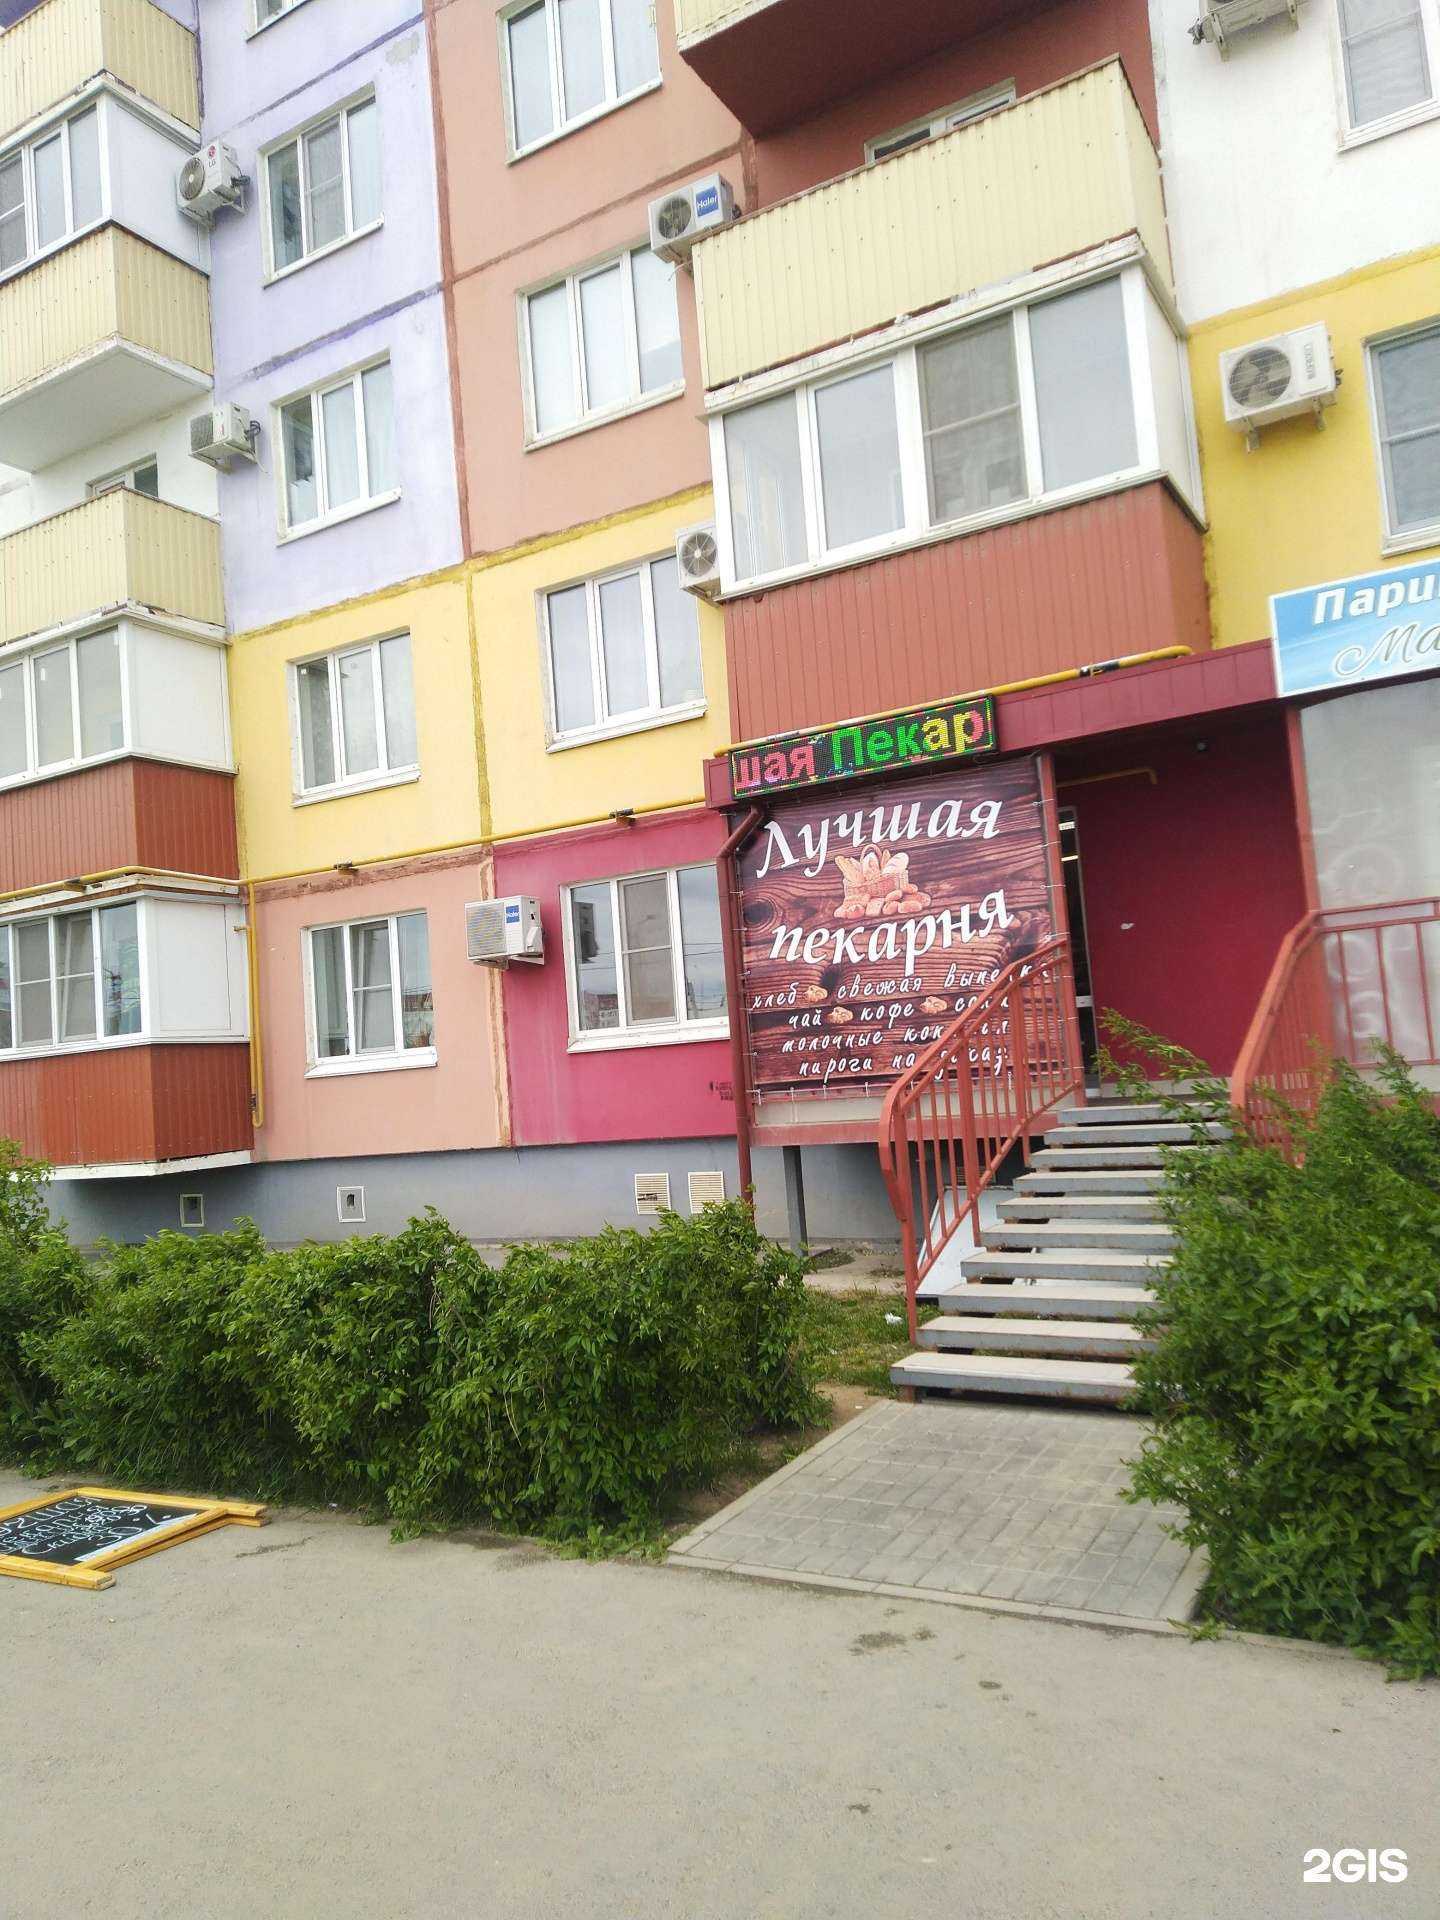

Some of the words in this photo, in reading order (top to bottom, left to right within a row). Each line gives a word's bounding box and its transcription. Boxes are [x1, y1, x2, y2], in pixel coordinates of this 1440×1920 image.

[1314, 574, 1440, 624] Пари
[832, 709, 983, 770] Пекар
[756, 800, 1003, 878] Лучшая
[768, 888, 1015, 977] пекарня
[752, 982, 799, 1010] хлеб
[837, 974, 922, 999] свежая
[944, 963, 1048, 988] выпек
[788, 1009, 822, 1029] чай
[860, 1003, 914, 1029] кофе
[782, 1031, 883, 1053] молочные
[892, 1053, 916, 1069] на
